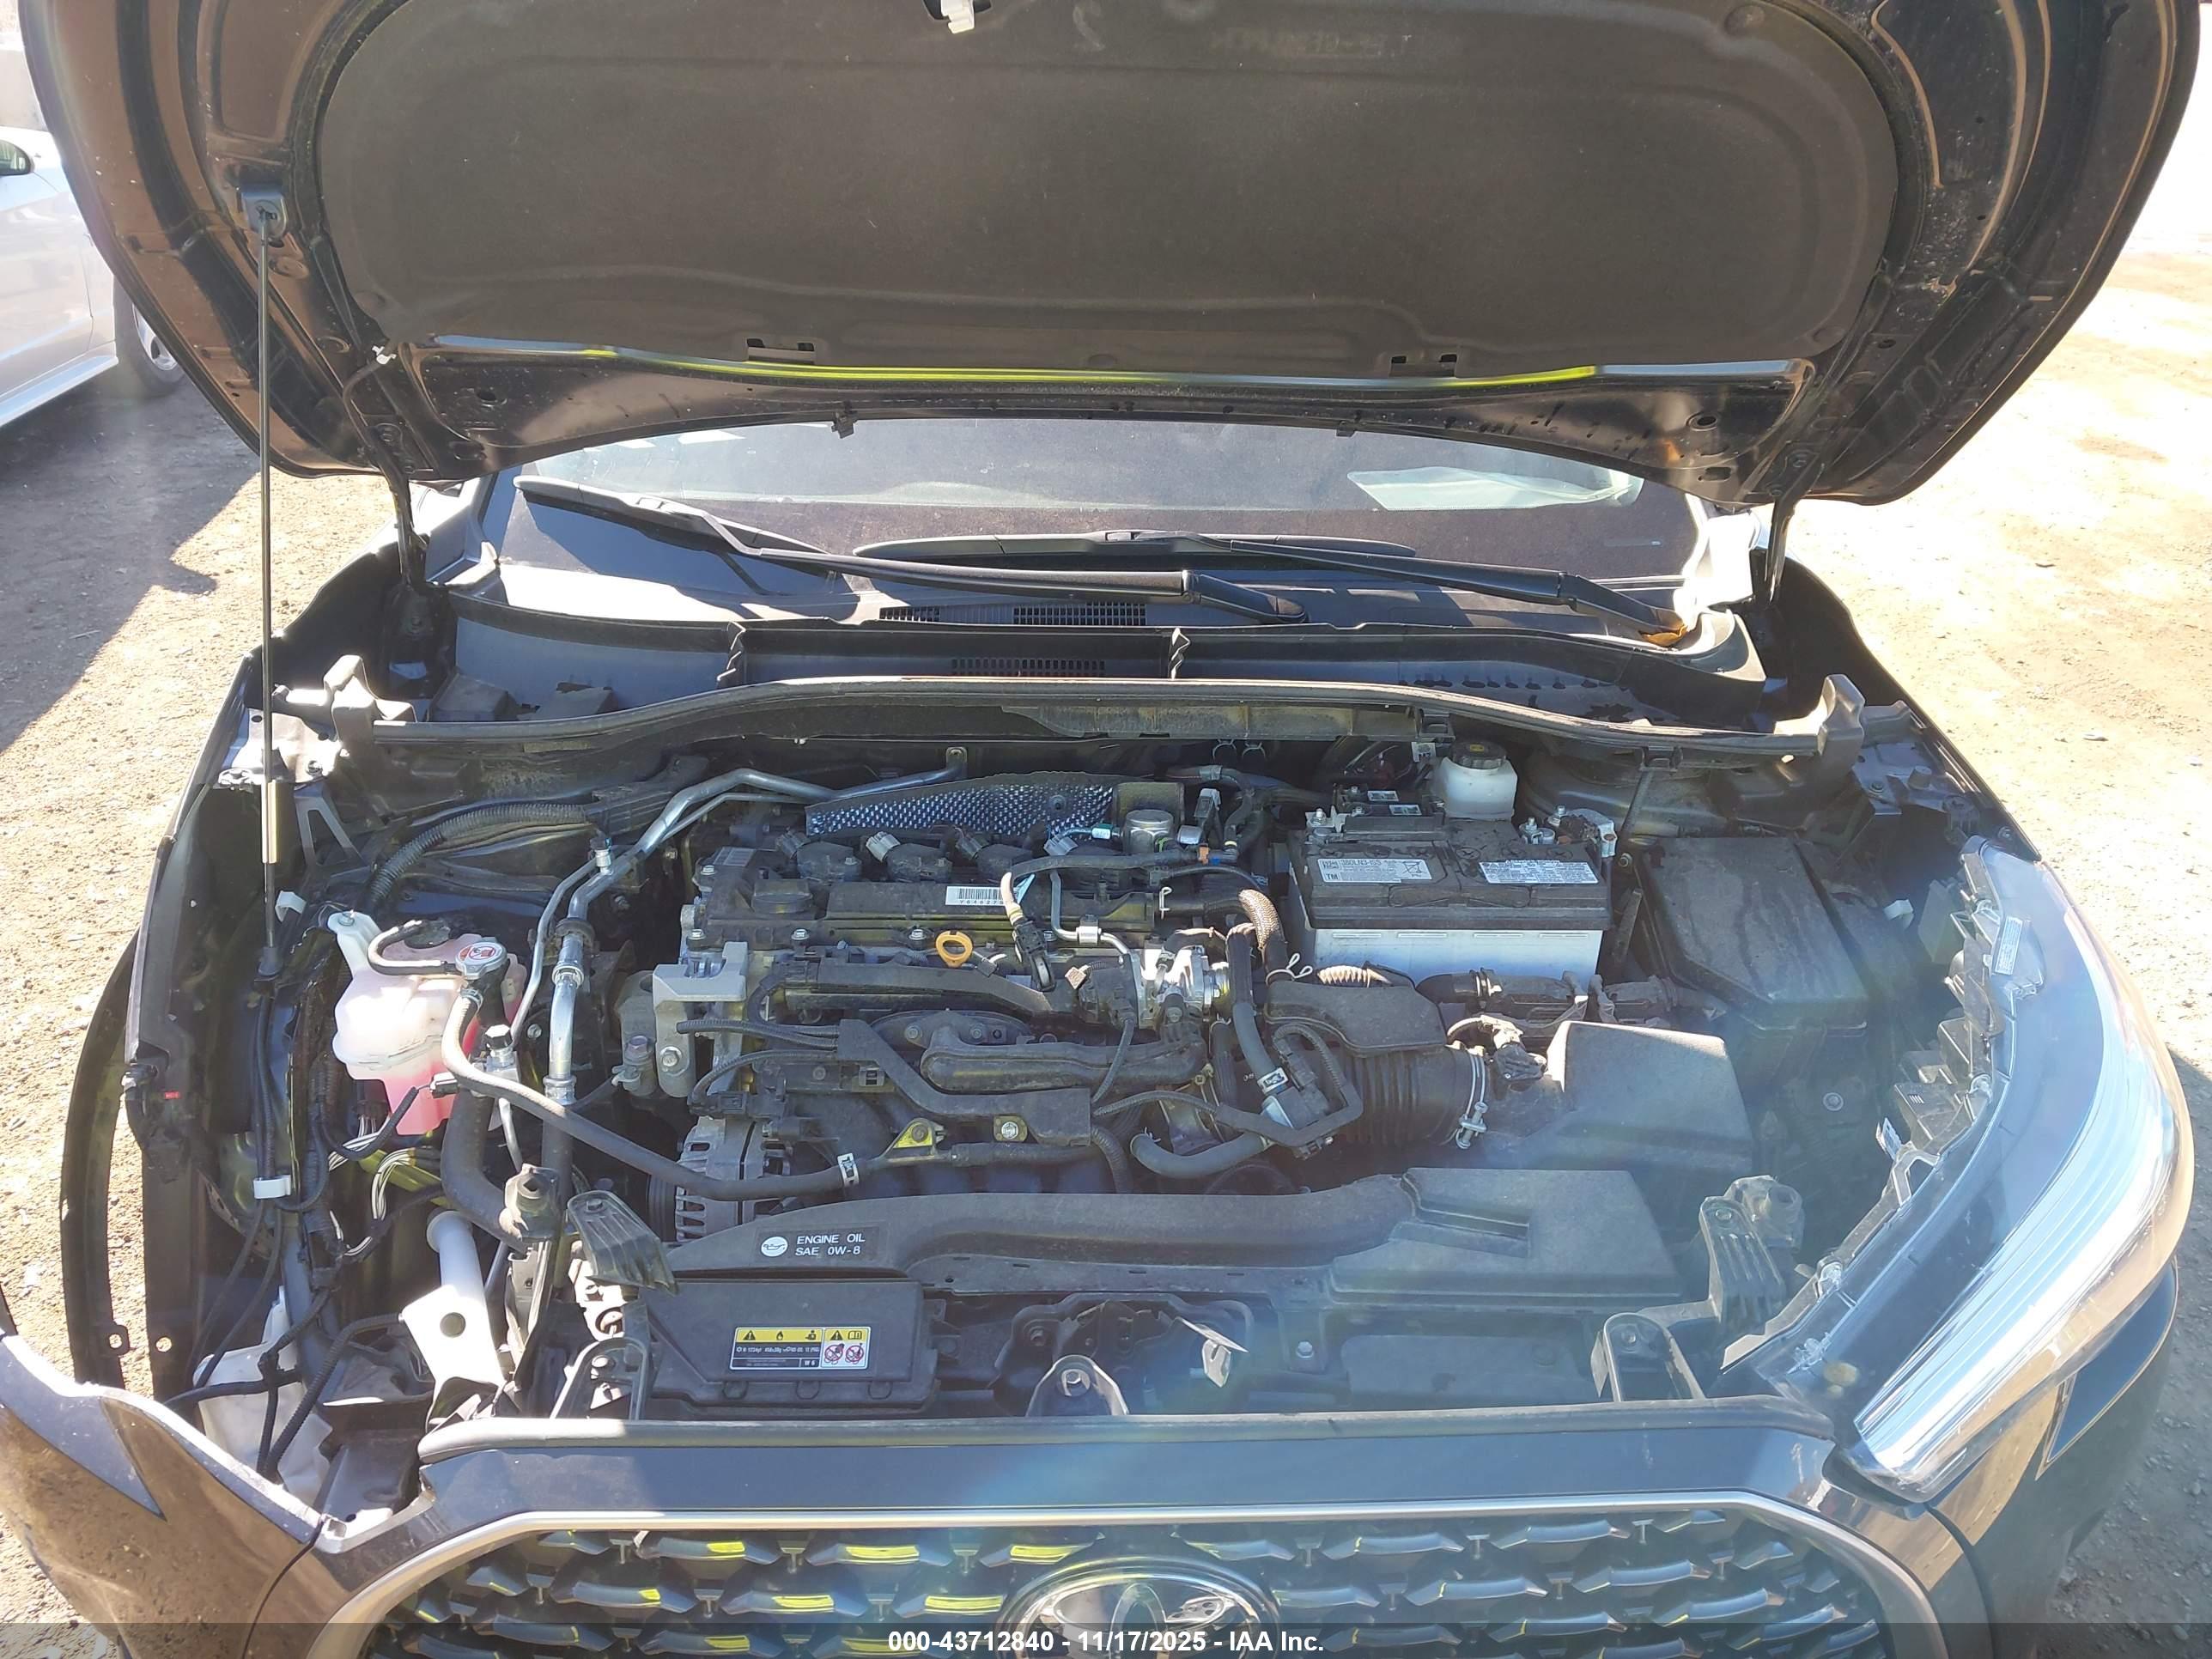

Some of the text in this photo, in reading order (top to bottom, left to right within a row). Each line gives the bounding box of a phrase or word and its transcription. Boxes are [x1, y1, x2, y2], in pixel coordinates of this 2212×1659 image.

[797, 1233, 866, 1245] ENGINE OIL
[795, 1245, 860, 1256] SAE 0W-8
